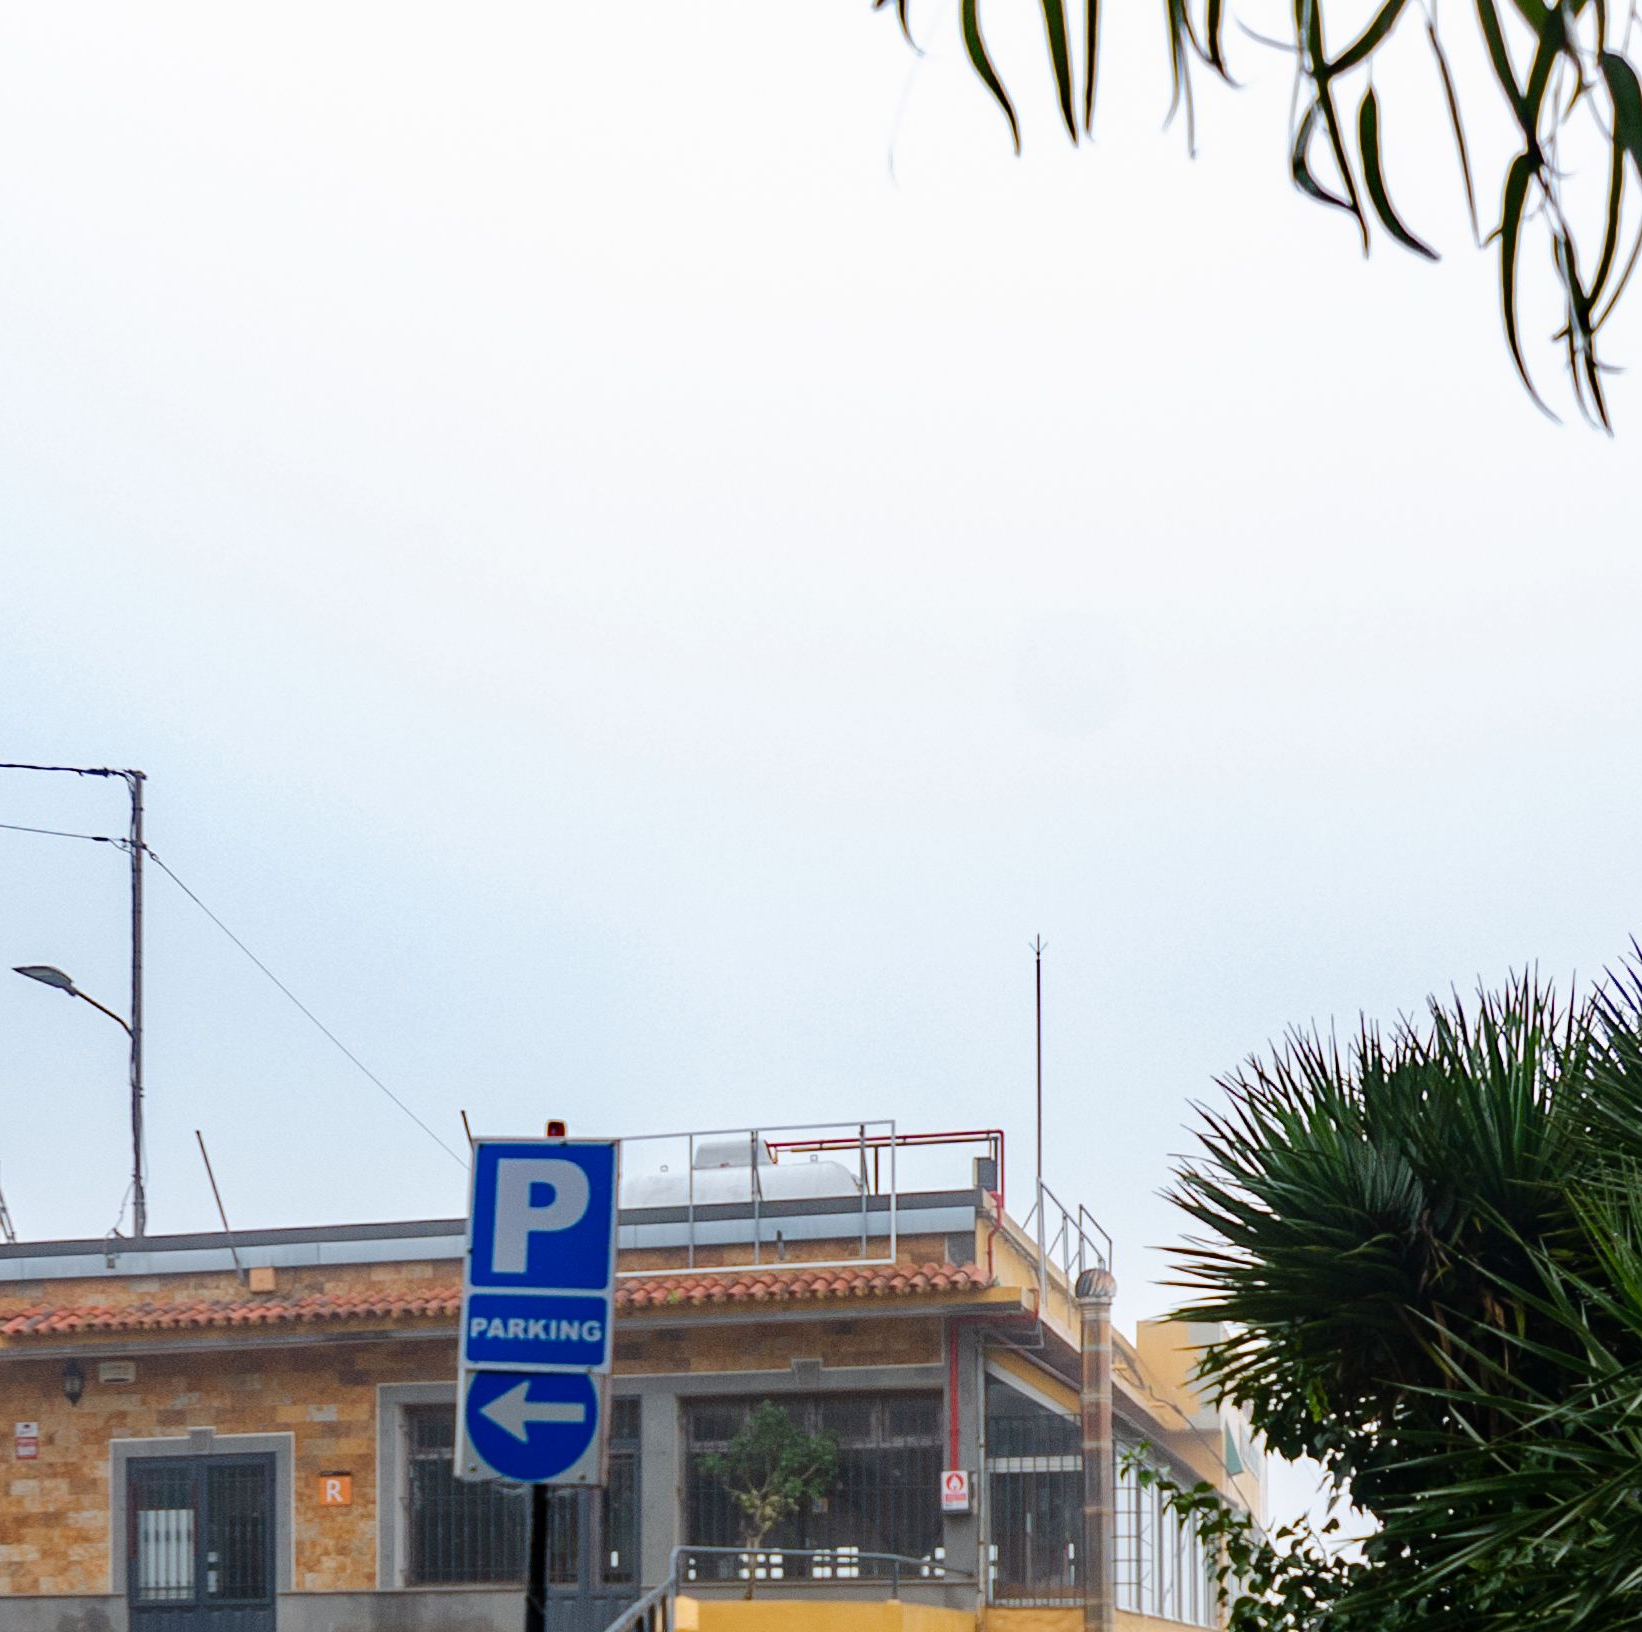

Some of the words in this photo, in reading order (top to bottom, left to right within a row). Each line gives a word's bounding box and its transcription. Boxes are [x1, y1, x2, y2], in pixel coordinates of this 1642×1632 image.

[491, 1158, 590, 1274] P
[469, 1317, 602, 1343] PARKING
[326, 1479, 343, 1503] R
